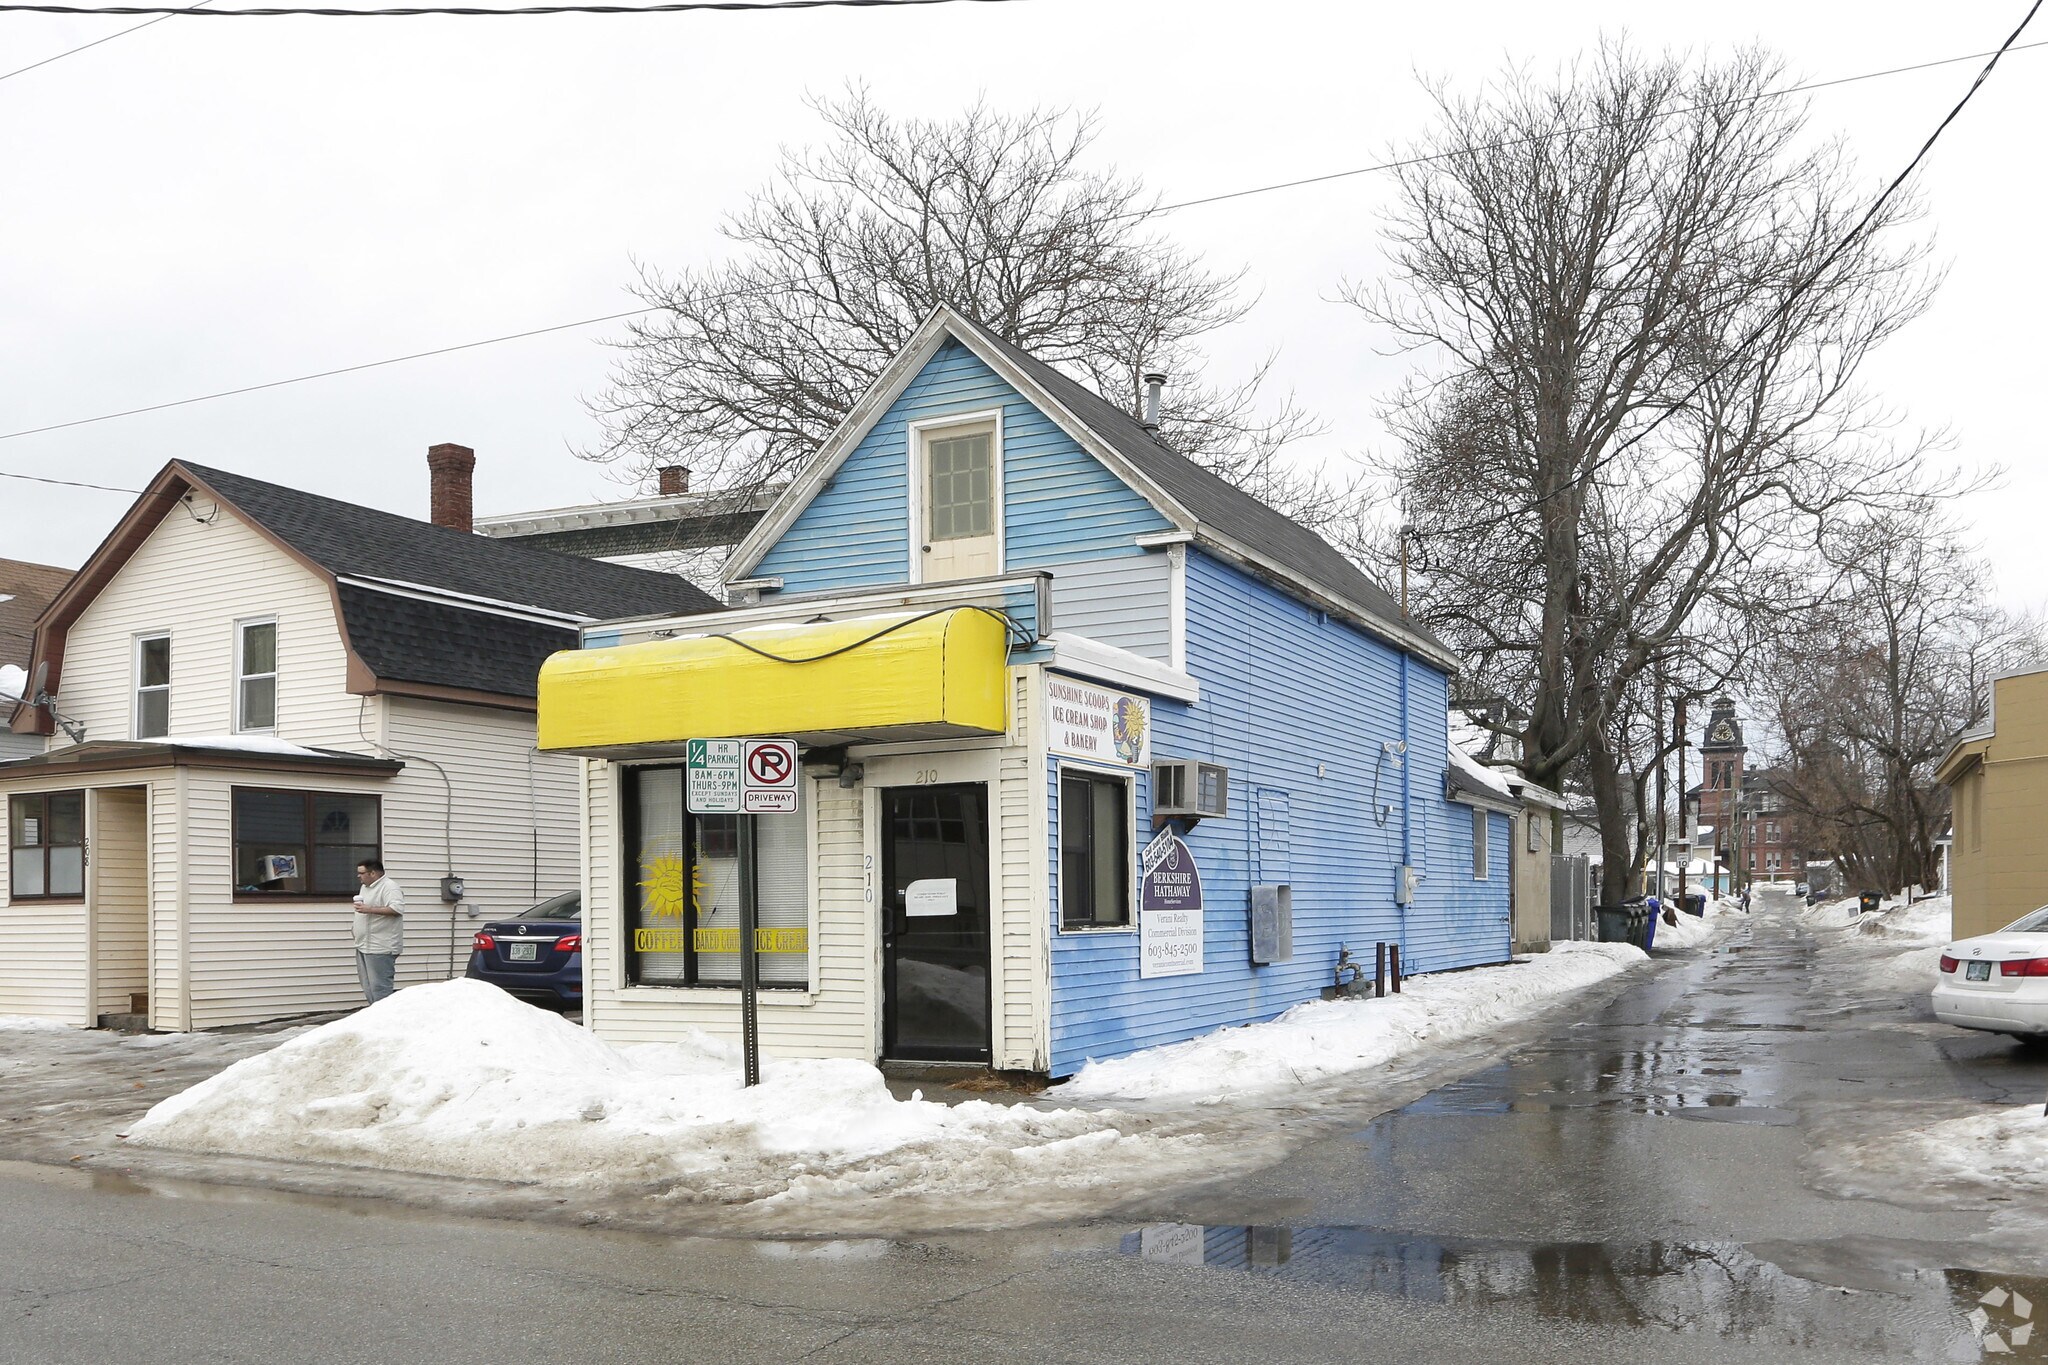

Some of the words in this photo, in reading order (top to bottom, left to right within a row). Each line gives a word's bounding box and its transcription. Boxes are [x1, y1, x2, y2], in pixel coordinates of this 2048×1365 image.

[1048, 682, 1083, 704] SUNSHINE
[1084, 690, 1110, 712] SCOOPS
[1052, 705, 1064, 722] ICE
[1065, 708, 1089, 728] CREAM
[1090, 714, 1108, 732] SHOP
[1064, 731, 1069, 747] &
[1071, 732, 1097, 752] BAKERY
[718, 744, 728, 753] HR
[707, 755, 739, 765] PARKING
[695, 770, 735, 780] 8AM-6PM
[915, 769, 938, 784] 210
[692, 781, 738, 790] THURS-9PM
[748, 794, 792, 802] DRIVEWAY
[865, 855, 873, 902] 210
[1153, 871, 1192, 884] BERKSHIRE
[1154, 885, 1191, 898] HATHAWAY
[1147, 927, 1177, 939] Commercial
[1178, 926, 1198, 937] Division
[756, 930, 773, 950] ICE
[1148, 941, 1198, 959] 603-845-2500
